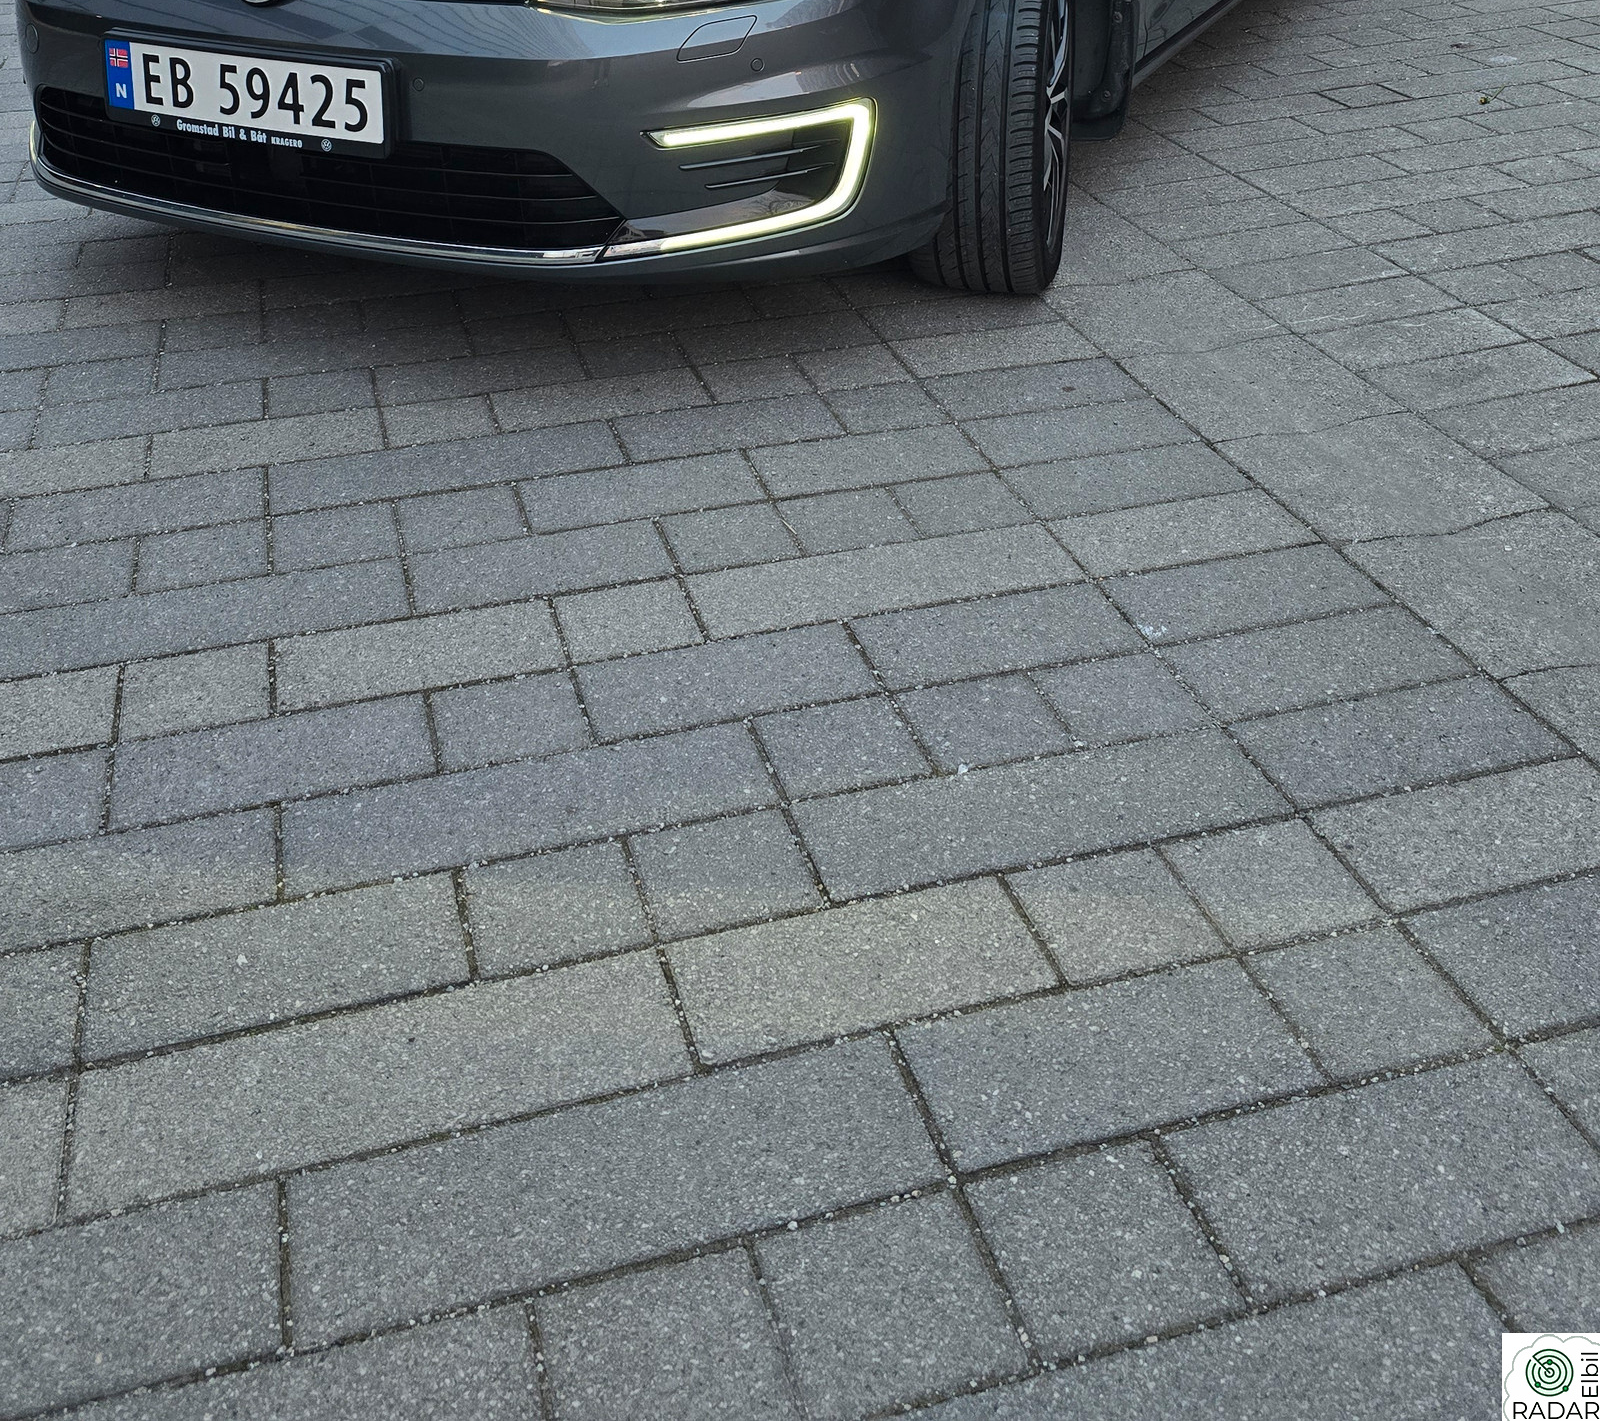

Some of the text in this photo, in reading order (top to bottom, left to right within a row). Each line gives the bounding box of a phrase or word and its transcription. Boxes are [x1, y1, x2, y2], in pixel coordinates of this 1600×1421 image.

[115, 83, 128, 98] N
[142, 53, 368, 133] EB 59425
[176, 119, 220, 136] Gromstad
[222, 126, 236, 139] Bil
[239, 128, 248, 141] &
[250, 130, 267, 143] Båt
